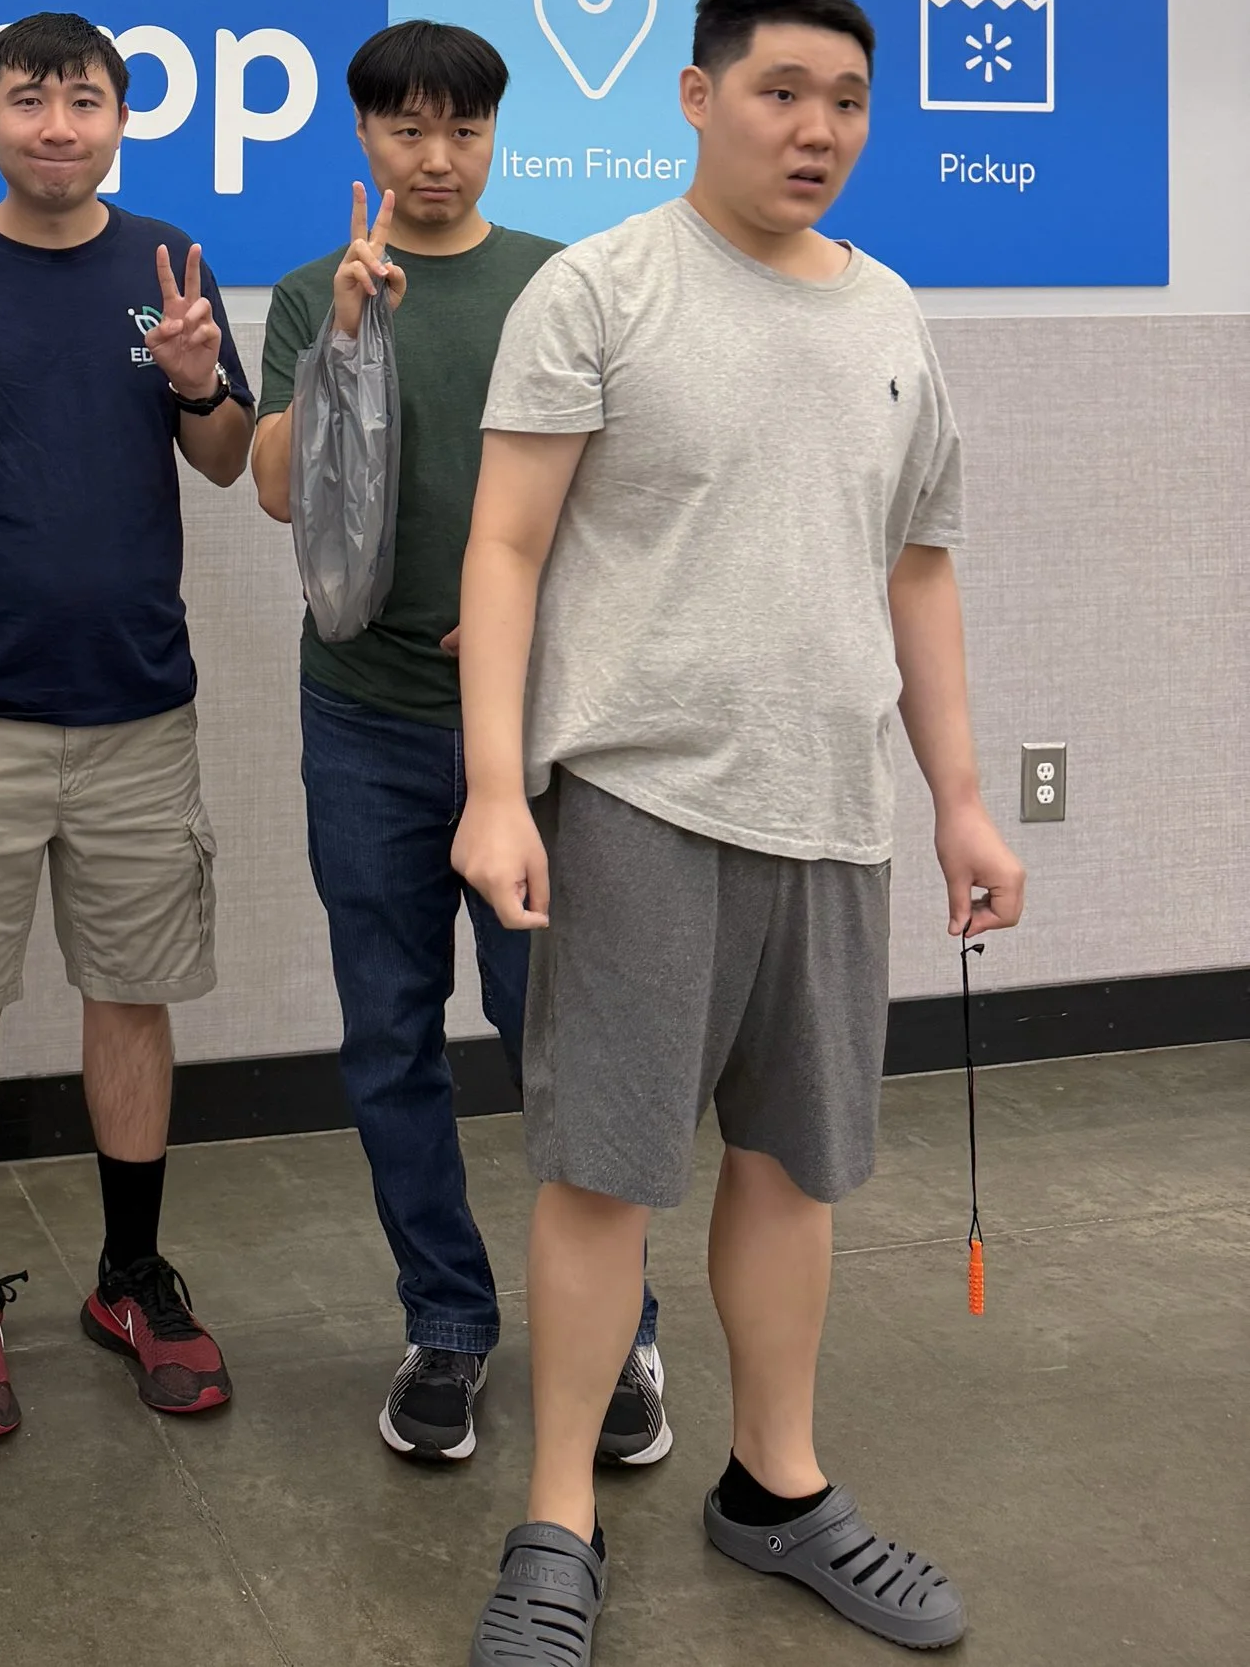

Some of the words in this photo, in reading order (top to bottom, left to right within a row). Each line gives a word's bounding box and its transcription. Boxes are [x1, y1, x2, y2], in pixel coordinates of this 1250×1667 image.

[503, 146, 573, 178] Item
[586, 148, 687, 179] Finder
[940, 152, 1036, 193] Pickup
